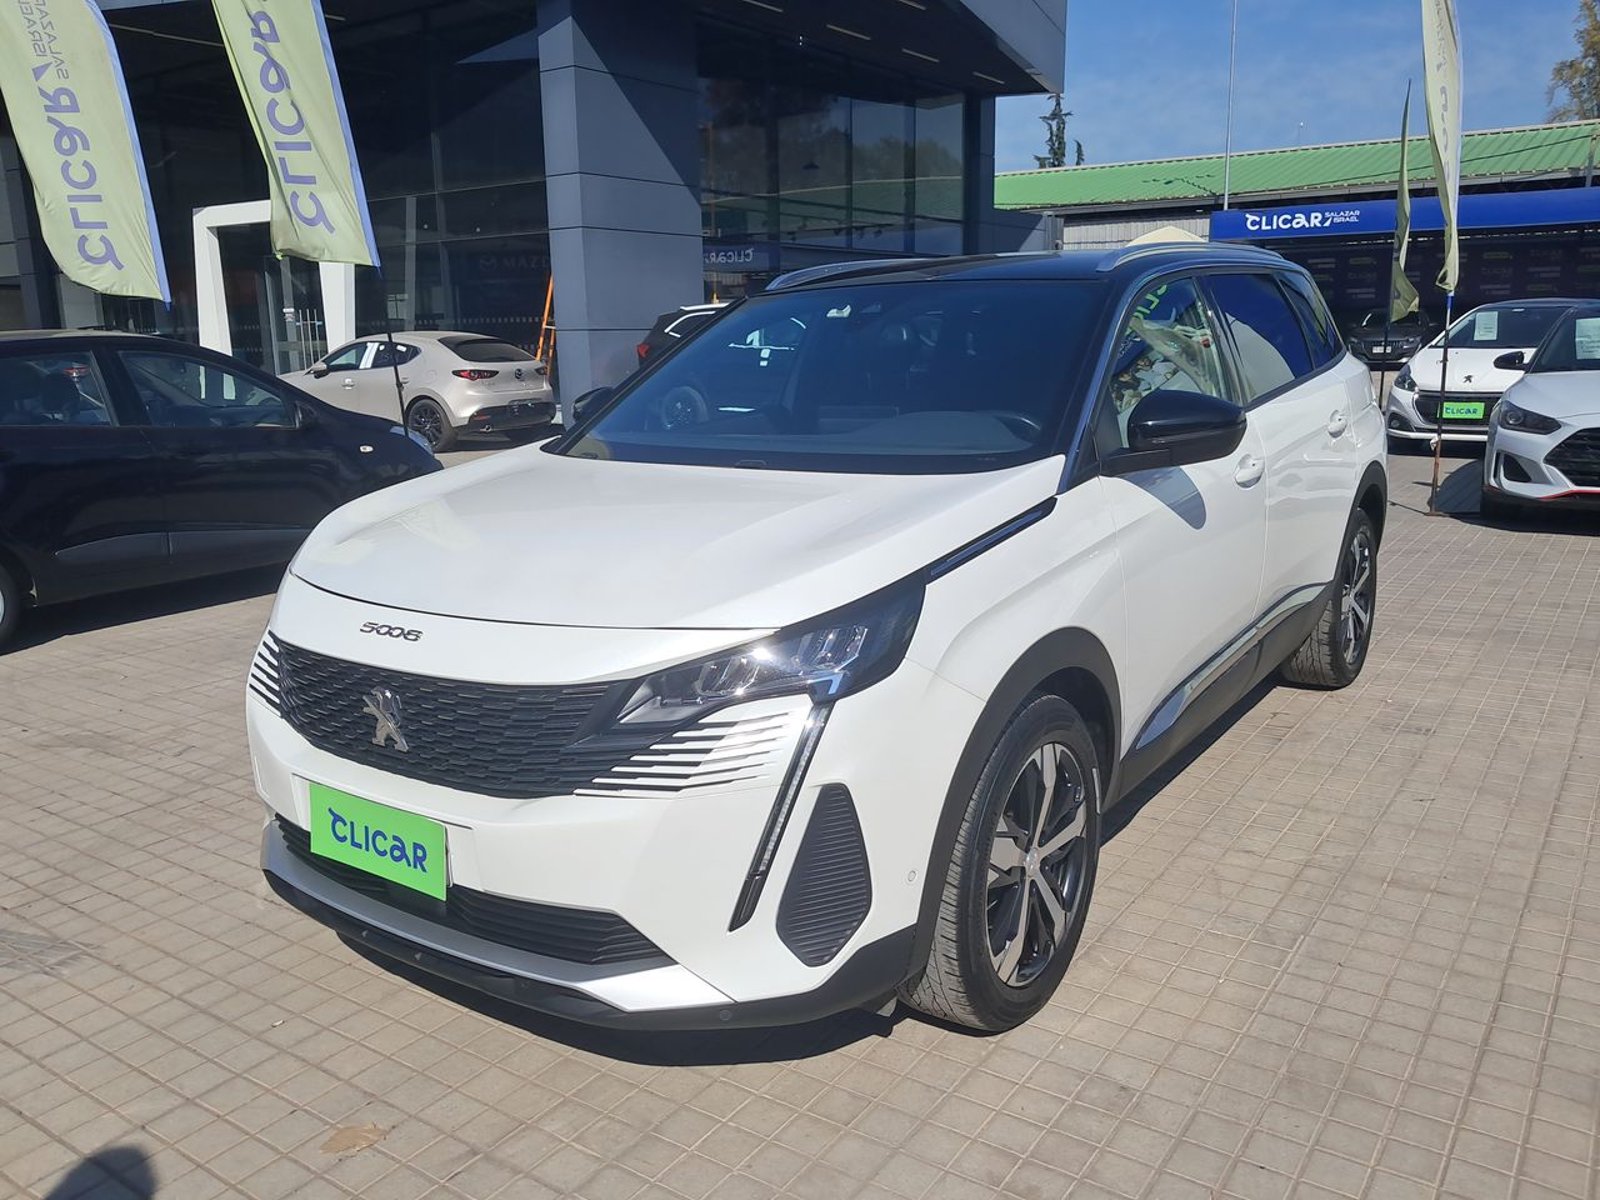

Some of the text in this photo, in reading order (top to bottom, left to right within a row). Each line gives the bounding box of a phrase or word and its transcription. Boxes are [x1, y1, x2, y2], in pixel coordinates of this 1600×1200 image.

[1324, 209, 1361, 218] SALAZAR
[1333, 215, 1360, 224] ISRAEL
[359, 621, 423, 642] 5008
